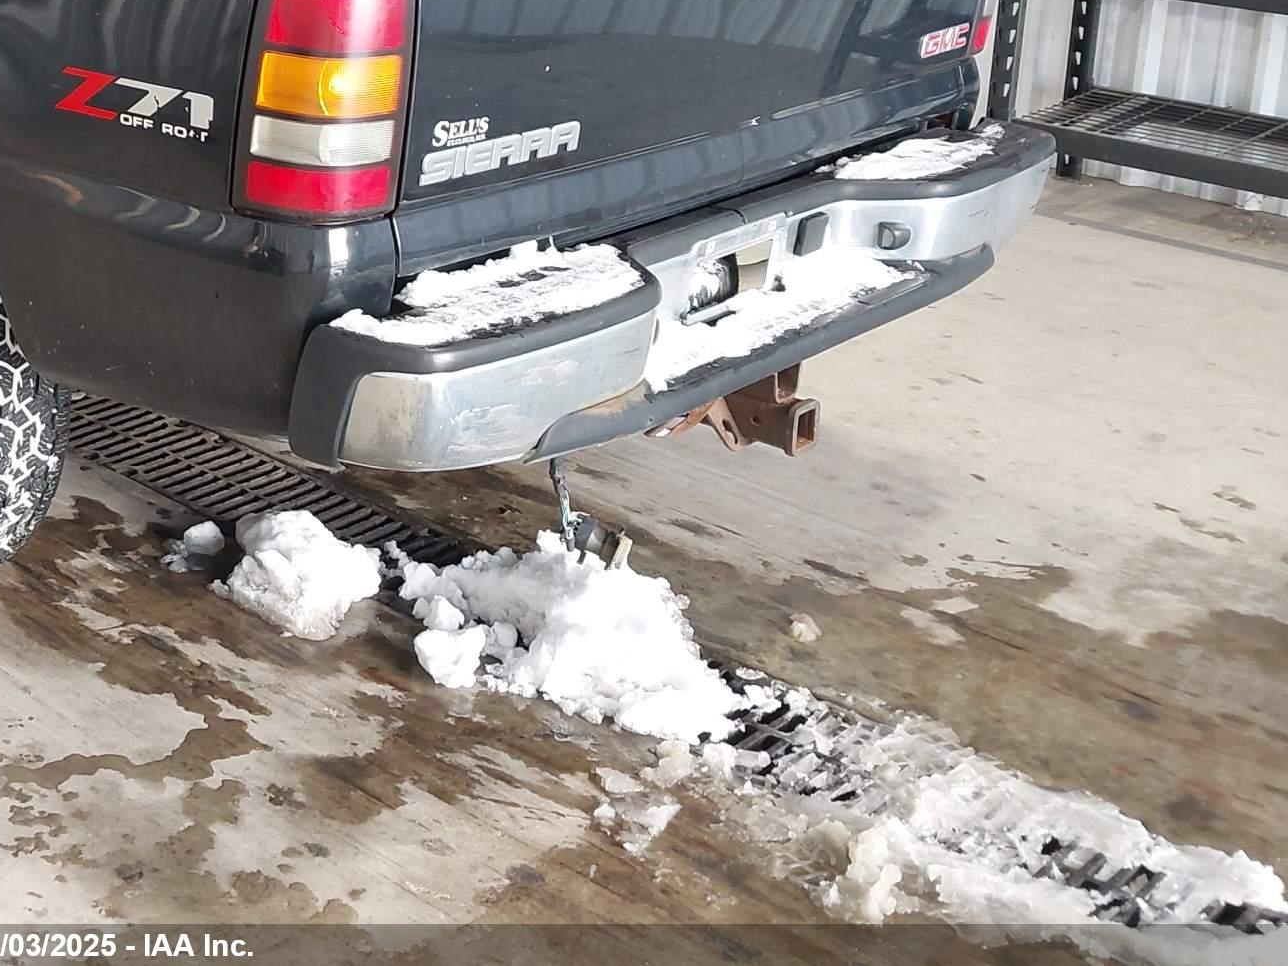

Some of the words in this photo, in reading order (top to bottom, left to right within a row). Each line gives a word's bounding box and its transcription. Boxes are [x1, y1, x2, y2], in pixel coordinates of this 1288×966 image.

[920, 22, 970, 59] GMC
[55, 66, 214, 130] Z71
[119, 113, 154, 130] OFF
[418, 120, 581, 187] SIERRA
